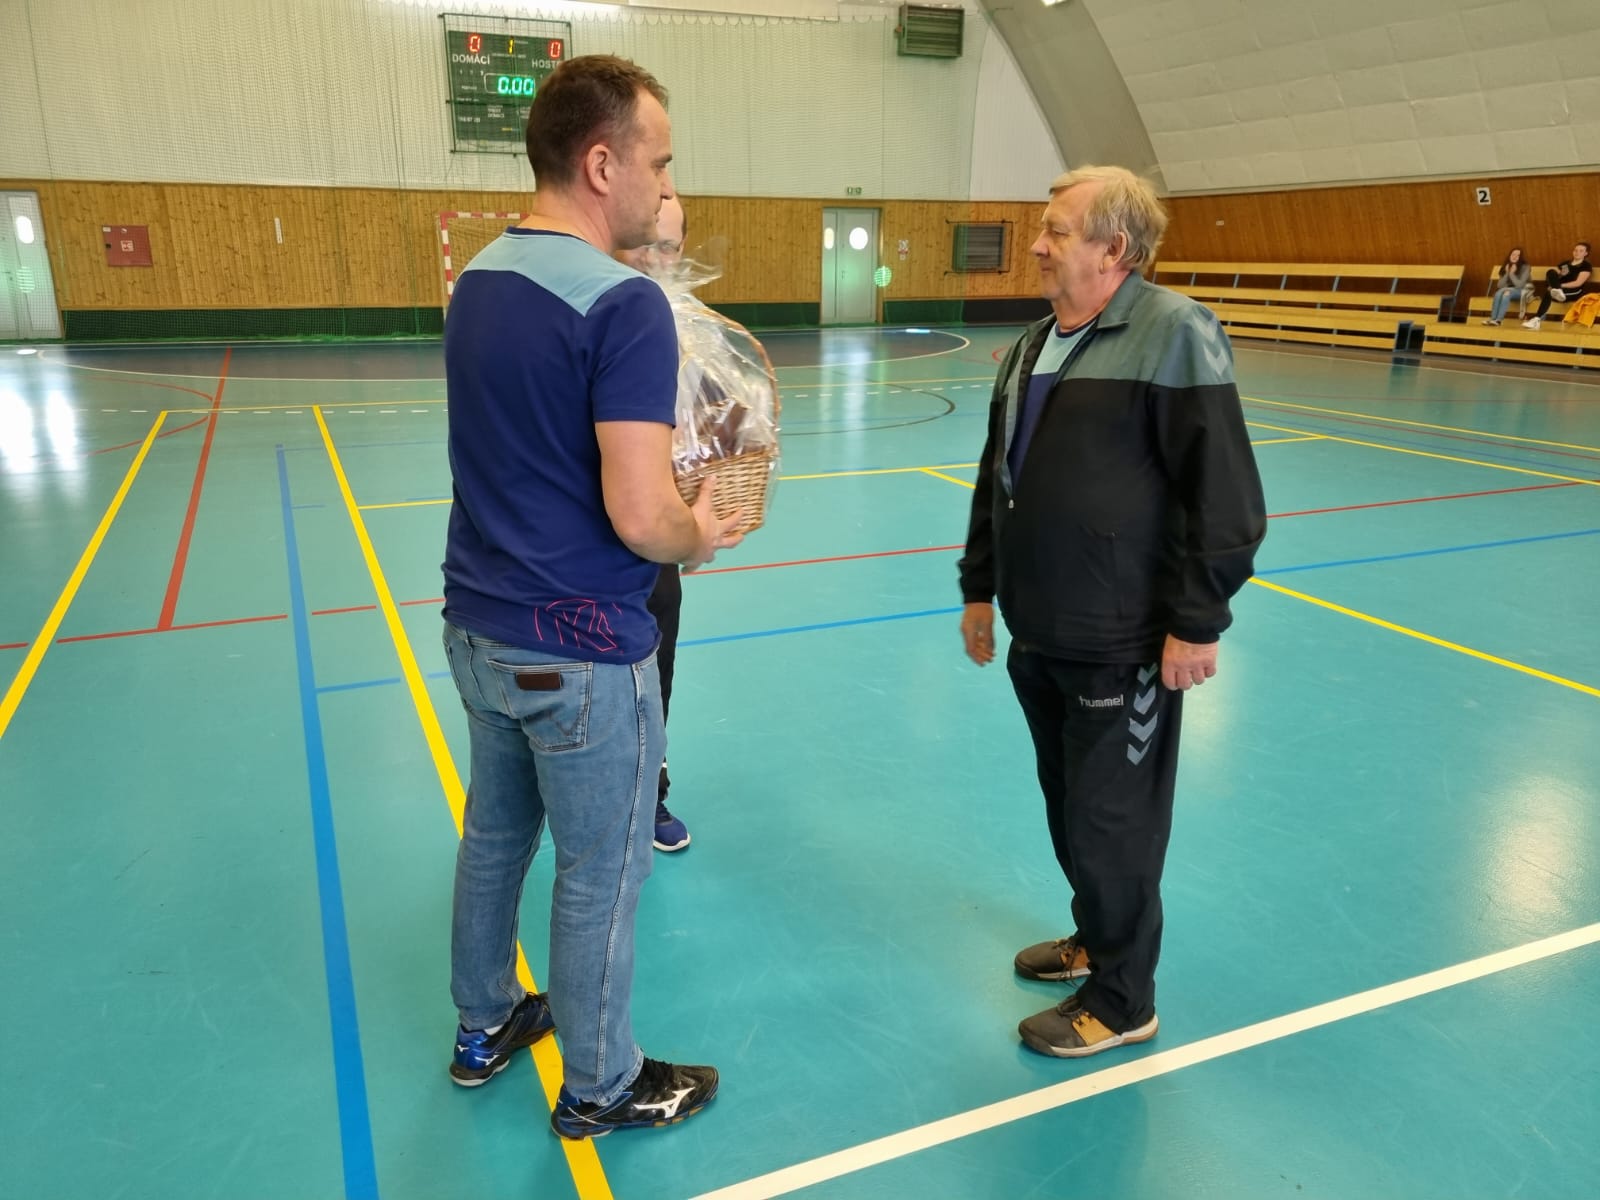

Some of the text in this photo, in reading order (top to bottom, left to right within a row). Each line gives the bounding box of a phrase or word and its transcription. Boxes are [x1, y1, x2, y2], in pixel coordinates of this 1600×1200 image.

[469, 35, 481, 52] 0
[508, 38, 514, 54] 1
[549, 41, 561, 58] 0
[531, 59, 559, 69] HOST
[1478, 190, 1490, 203] 2
[1079, 694, 1124, 708] hummel
